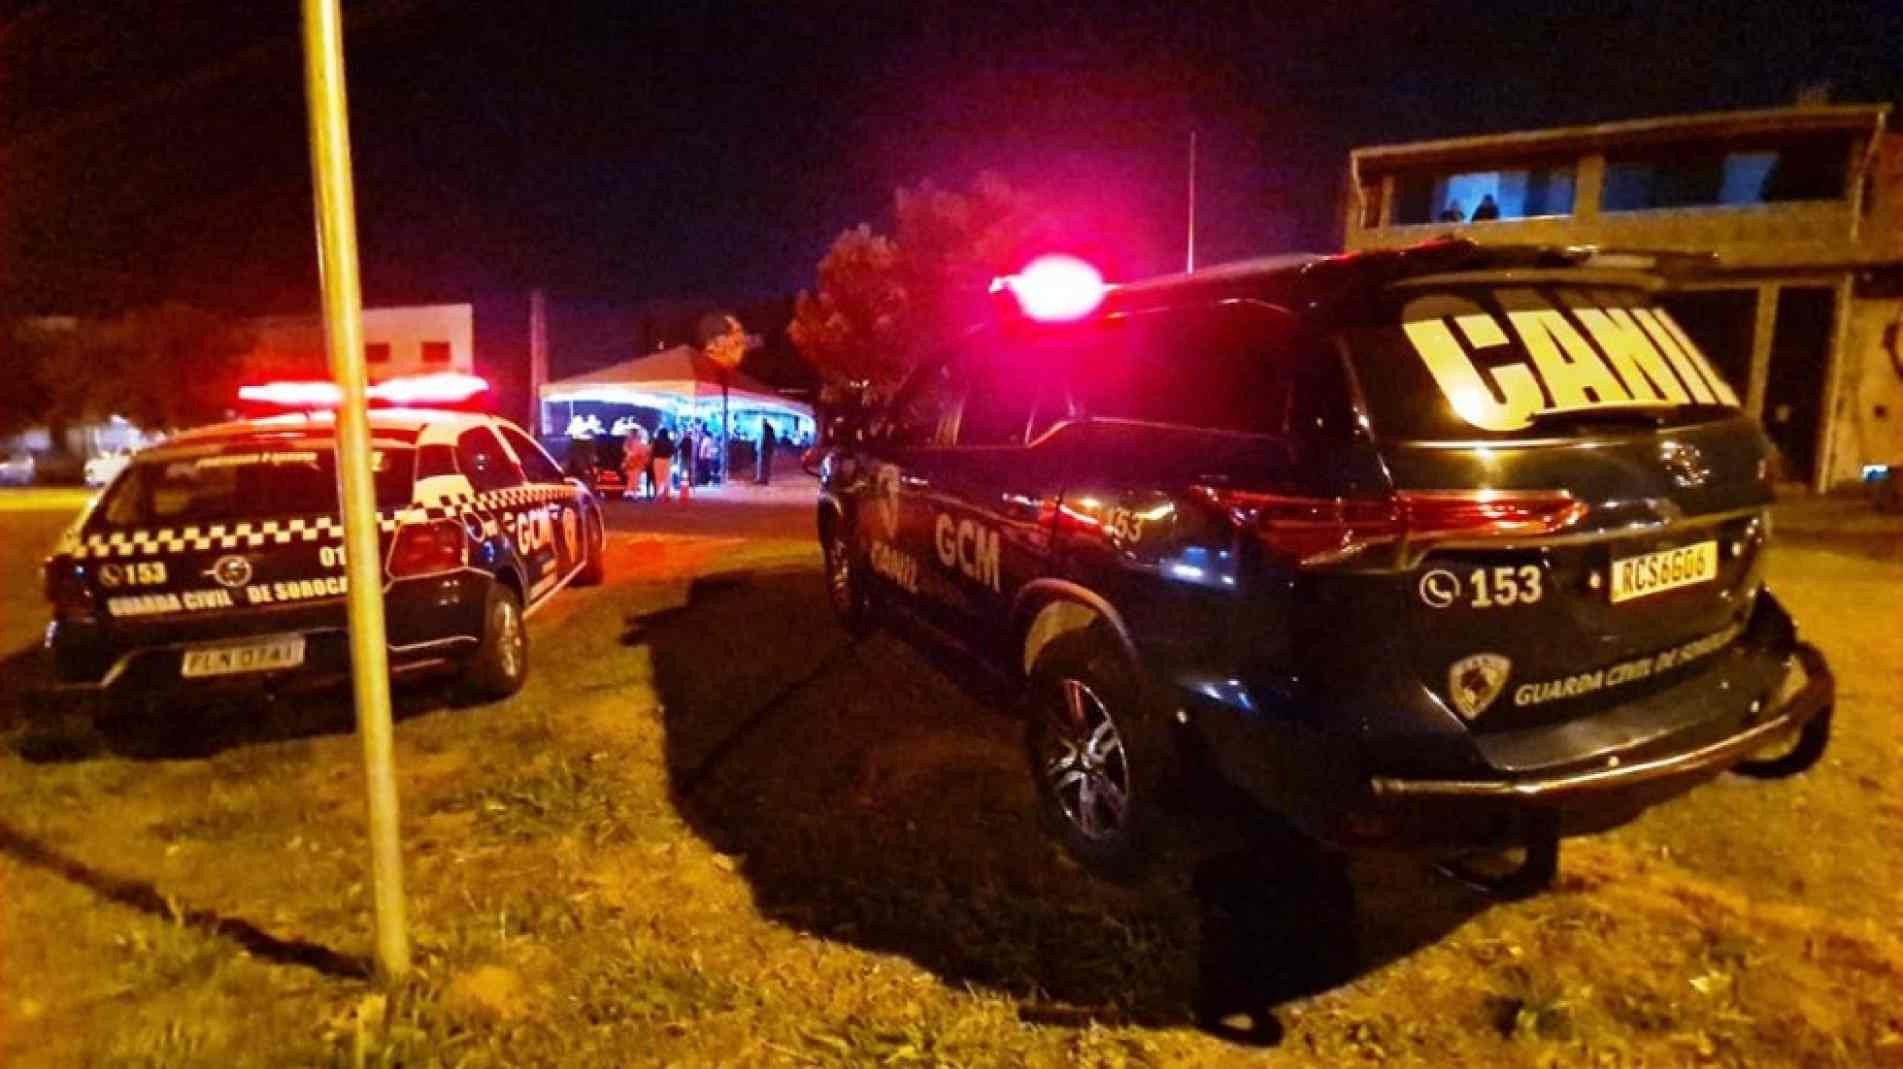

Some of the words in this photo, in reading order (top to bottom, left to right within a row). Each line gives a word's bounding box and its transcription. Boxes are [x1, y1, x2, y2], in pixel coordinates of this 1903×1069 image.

[1402, 291, 1741, 432] CANIL
[936, 513, 999, 593] GCM
[125, 561, 167, 585] 153
[246, 584, 273, 604] DE
[275, 577, 348, 600] SOROCA
[1470, 565, 1543, 607] 153
[1515, 671, 1602, 705] GUARDA
